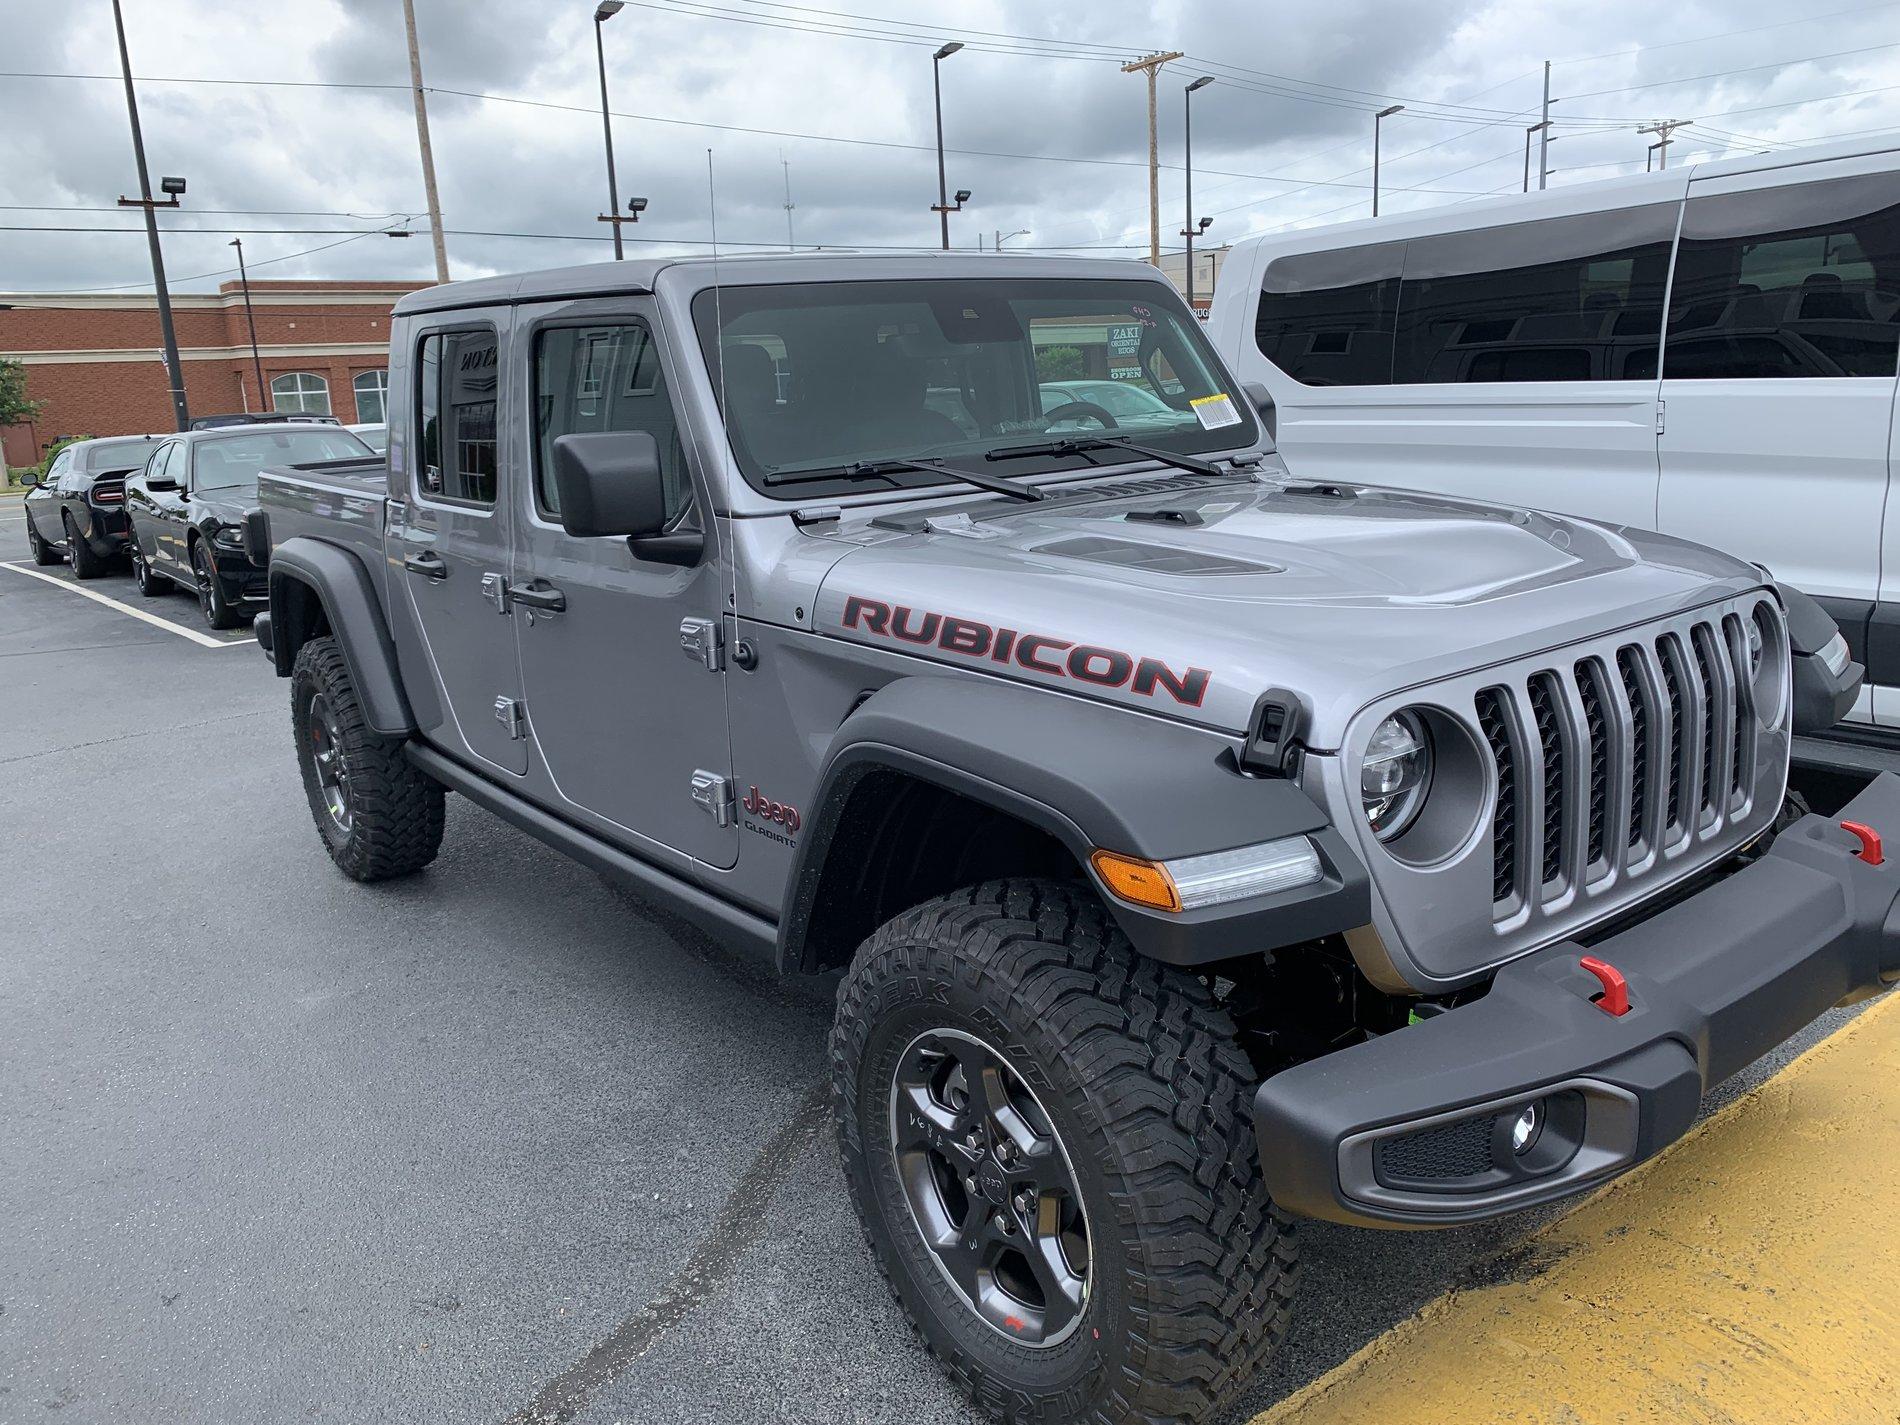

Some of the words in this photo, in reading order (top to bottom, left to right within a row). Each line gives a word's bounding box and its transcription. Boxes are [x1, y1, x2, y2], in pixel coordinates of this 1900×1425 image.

[1113, 327, 1139, 340] ZAKI
[1117, 346, 1136, 355] RUGS
[1110, 371, 1141, 380] OPEN
[841, 596, 1212, 708] RUBICON
[742, 785, 801, 836] Jeep
